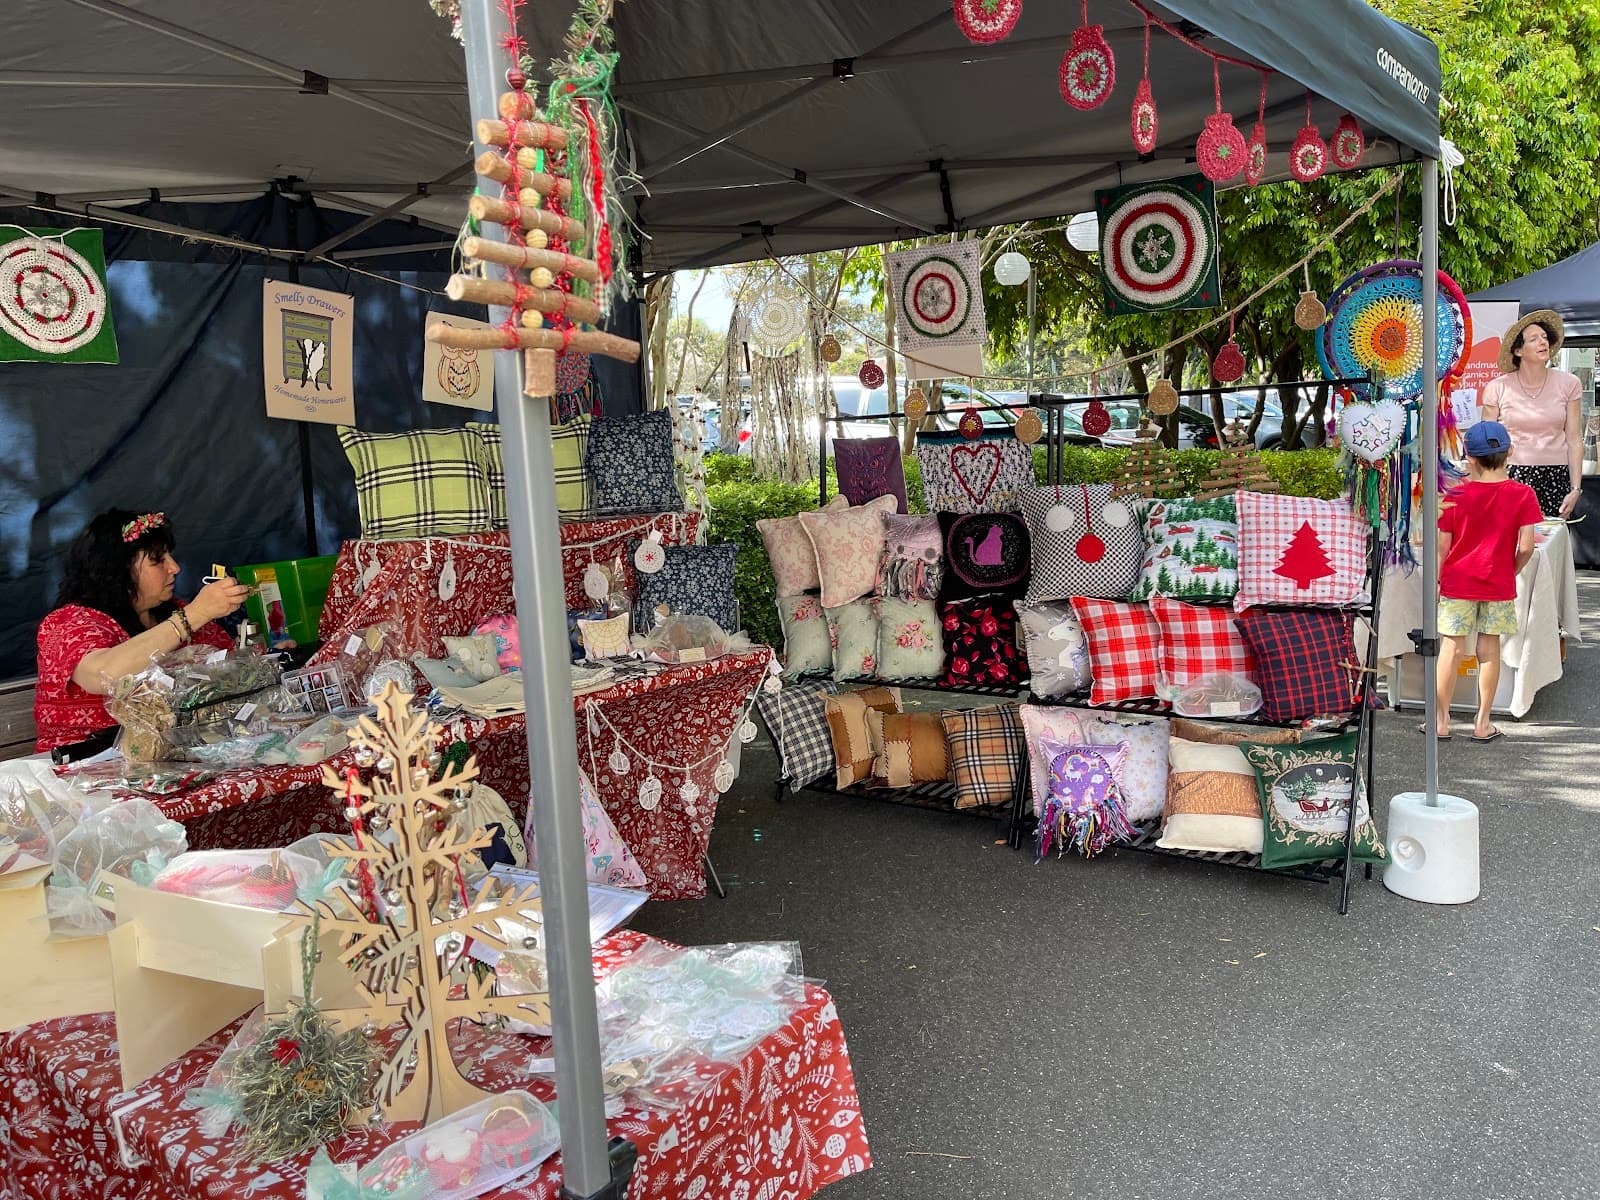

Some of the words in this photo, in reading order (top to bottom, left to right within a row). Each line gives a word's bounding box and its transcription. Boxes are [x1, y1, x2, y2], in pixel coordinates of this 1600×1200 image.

[274, 291, 305, 308] Smelly
[306, 295, 346, 318] Drawers
[1465, 361, 1498, 369] andmad
[1491, 370, 1504, 378] for
[272, 384, 310, 403] Homemade
[311, 395, 346, 405] Homewares
